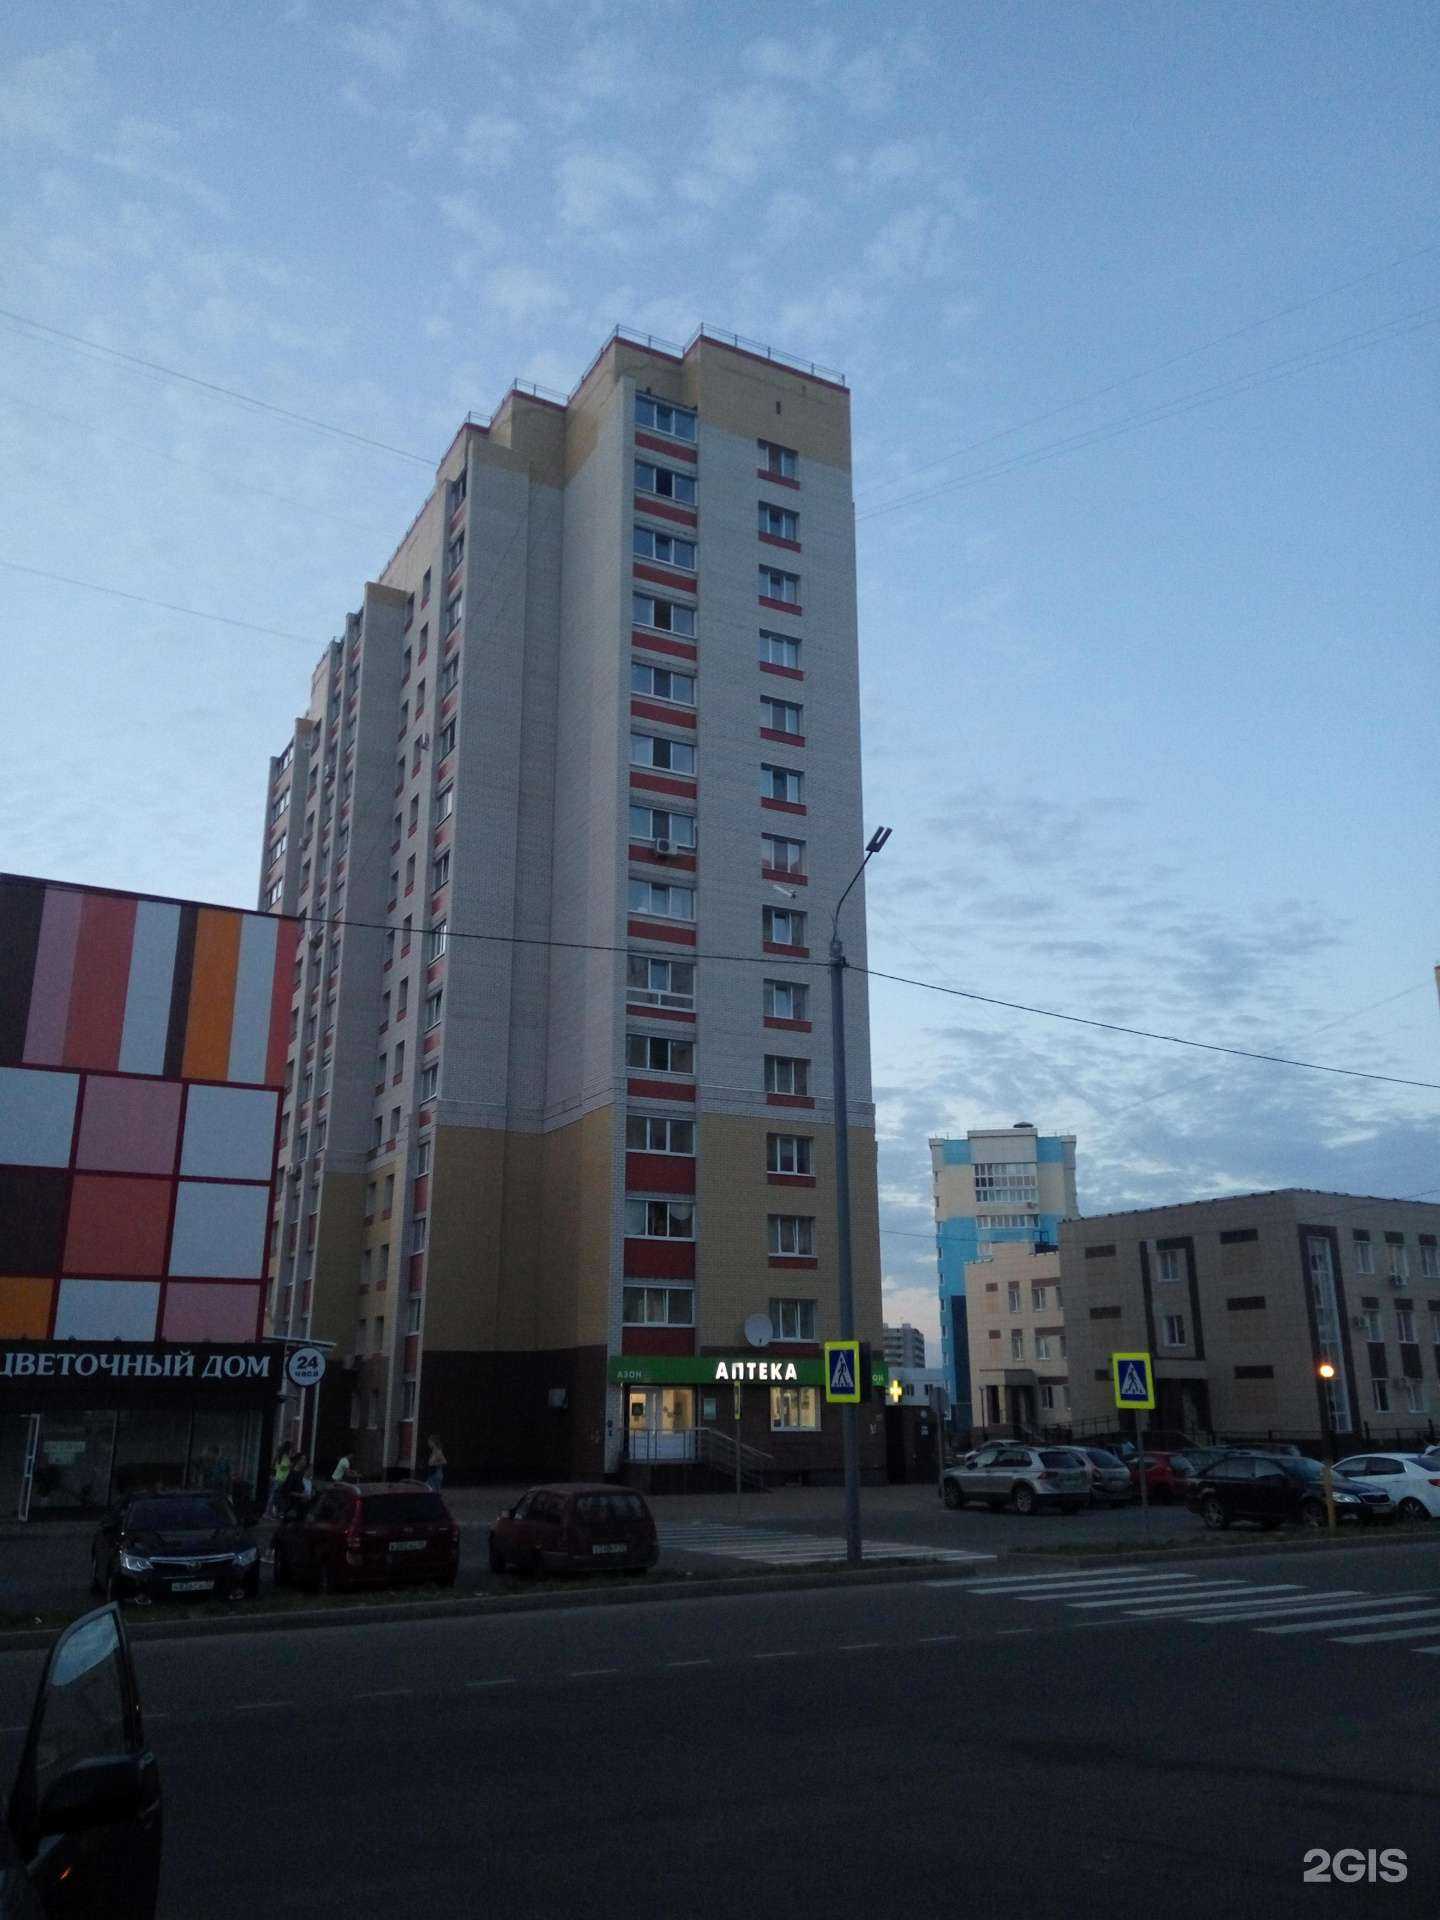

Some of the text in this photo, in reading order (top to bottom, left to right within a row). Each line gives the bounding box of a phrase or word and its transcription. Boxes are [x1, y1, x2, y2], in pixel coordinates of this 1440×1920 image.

[201, 1355, 271, 1378] ДОМ
[297, 1356, 318, 1370] 24
[714, 1361, 798, 1381] АПТЕКА
